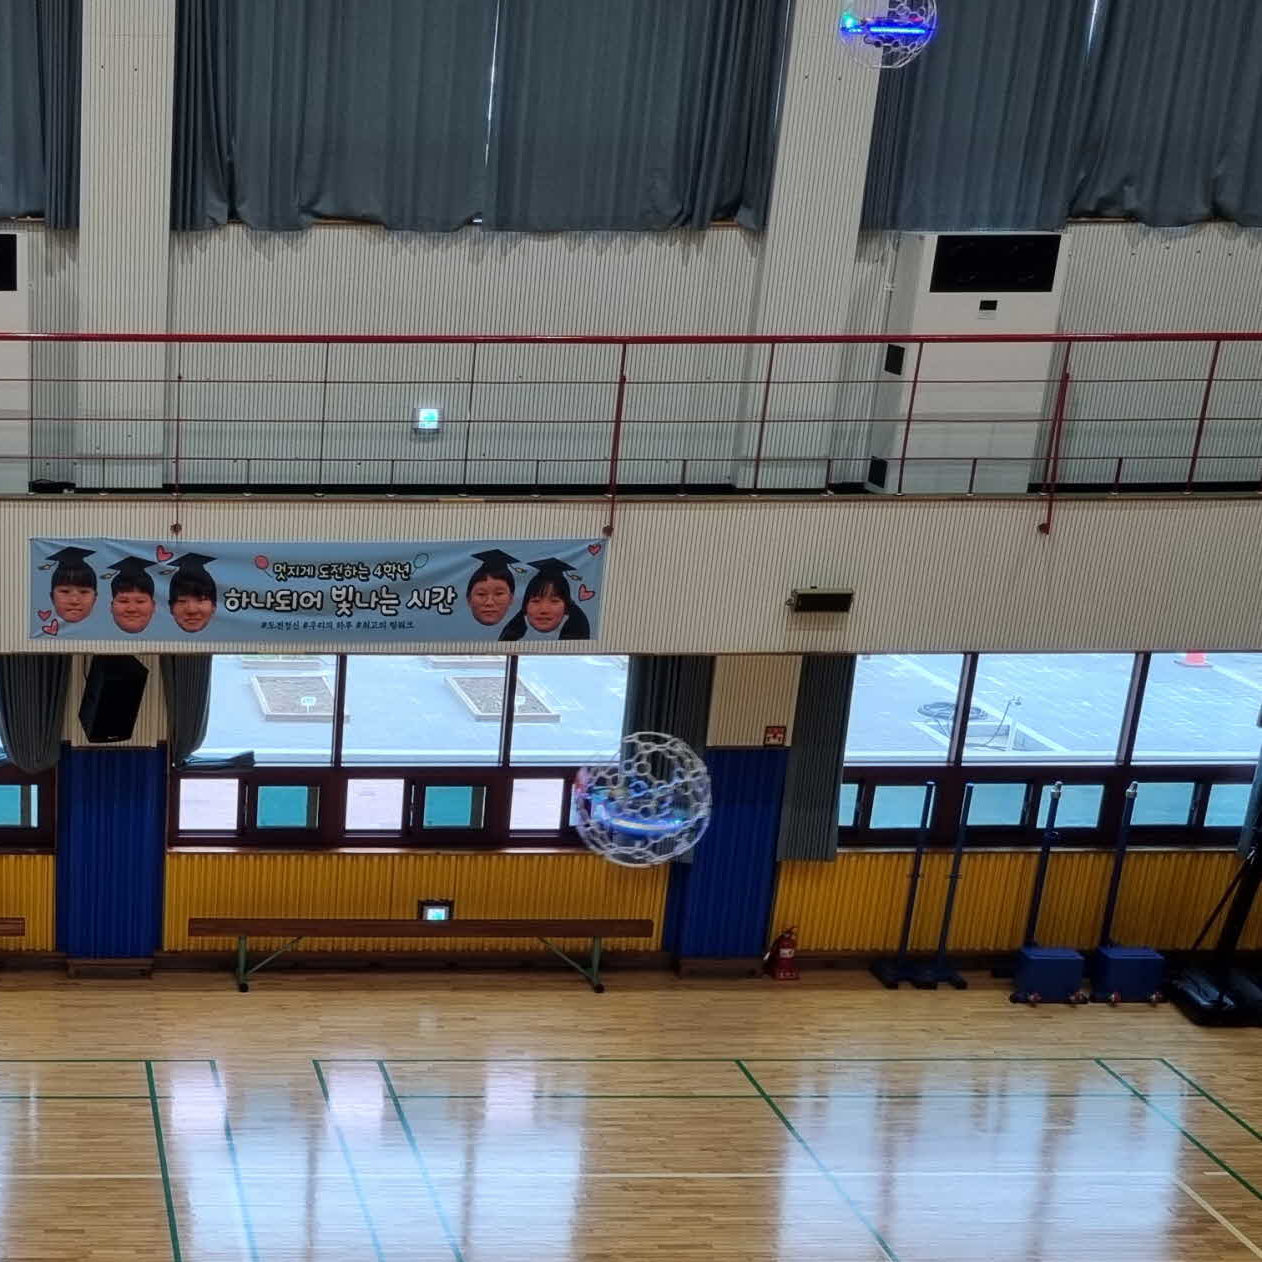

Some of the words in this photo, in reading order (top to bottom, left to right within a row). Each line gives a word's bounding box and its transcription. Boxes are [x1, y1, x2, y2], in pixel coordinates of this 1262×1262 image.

[273, 562, 314, 581] 멋지게
[317, 563, 370, 581] 도전하는
[372, 563, 411, 581] 4학년
[224, 588, 323, 612] 하나되어
[331, 585, 401, 616] 빛나는
[405, 586, 456, 616] 시간
